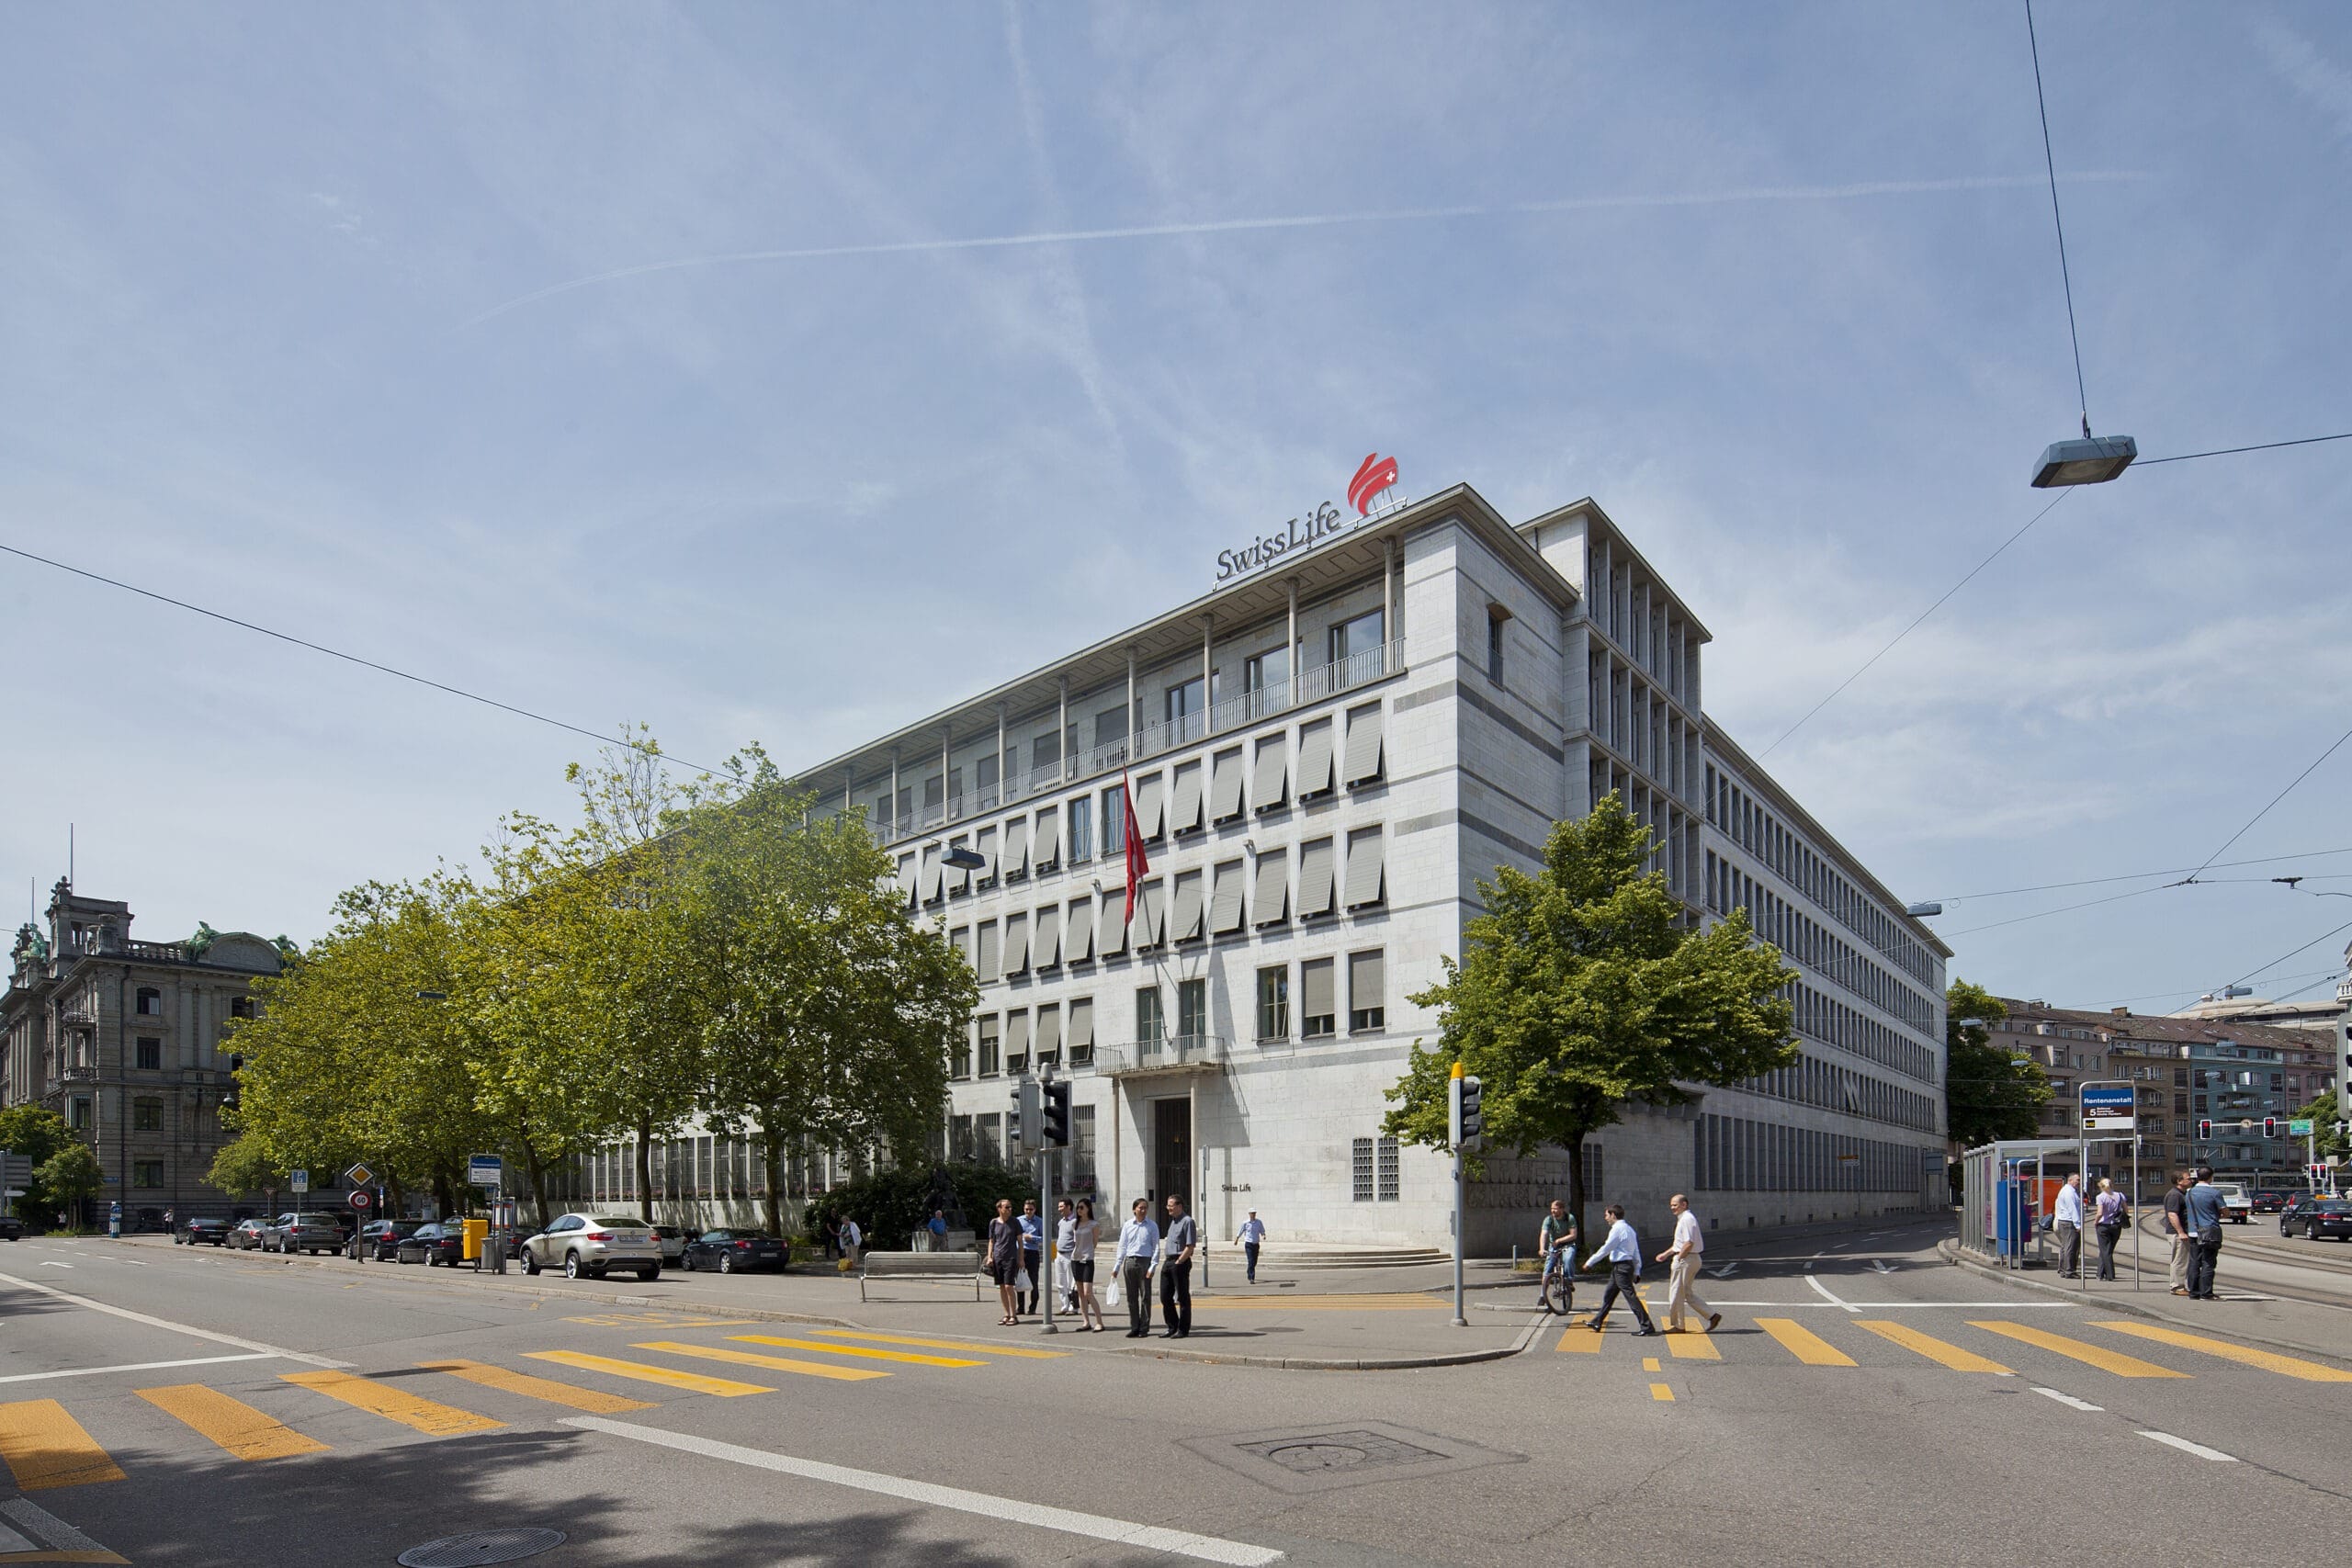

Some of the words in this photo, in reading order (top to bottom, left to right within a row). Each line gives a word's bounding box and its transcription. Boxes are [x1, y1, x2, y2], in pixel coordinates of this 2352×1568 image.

[1216, 501, 1341, 581] SwissLife
[1221, 1184, 1238, 1192] Swiss
[1239, 1183, 1251, 1192] Life
